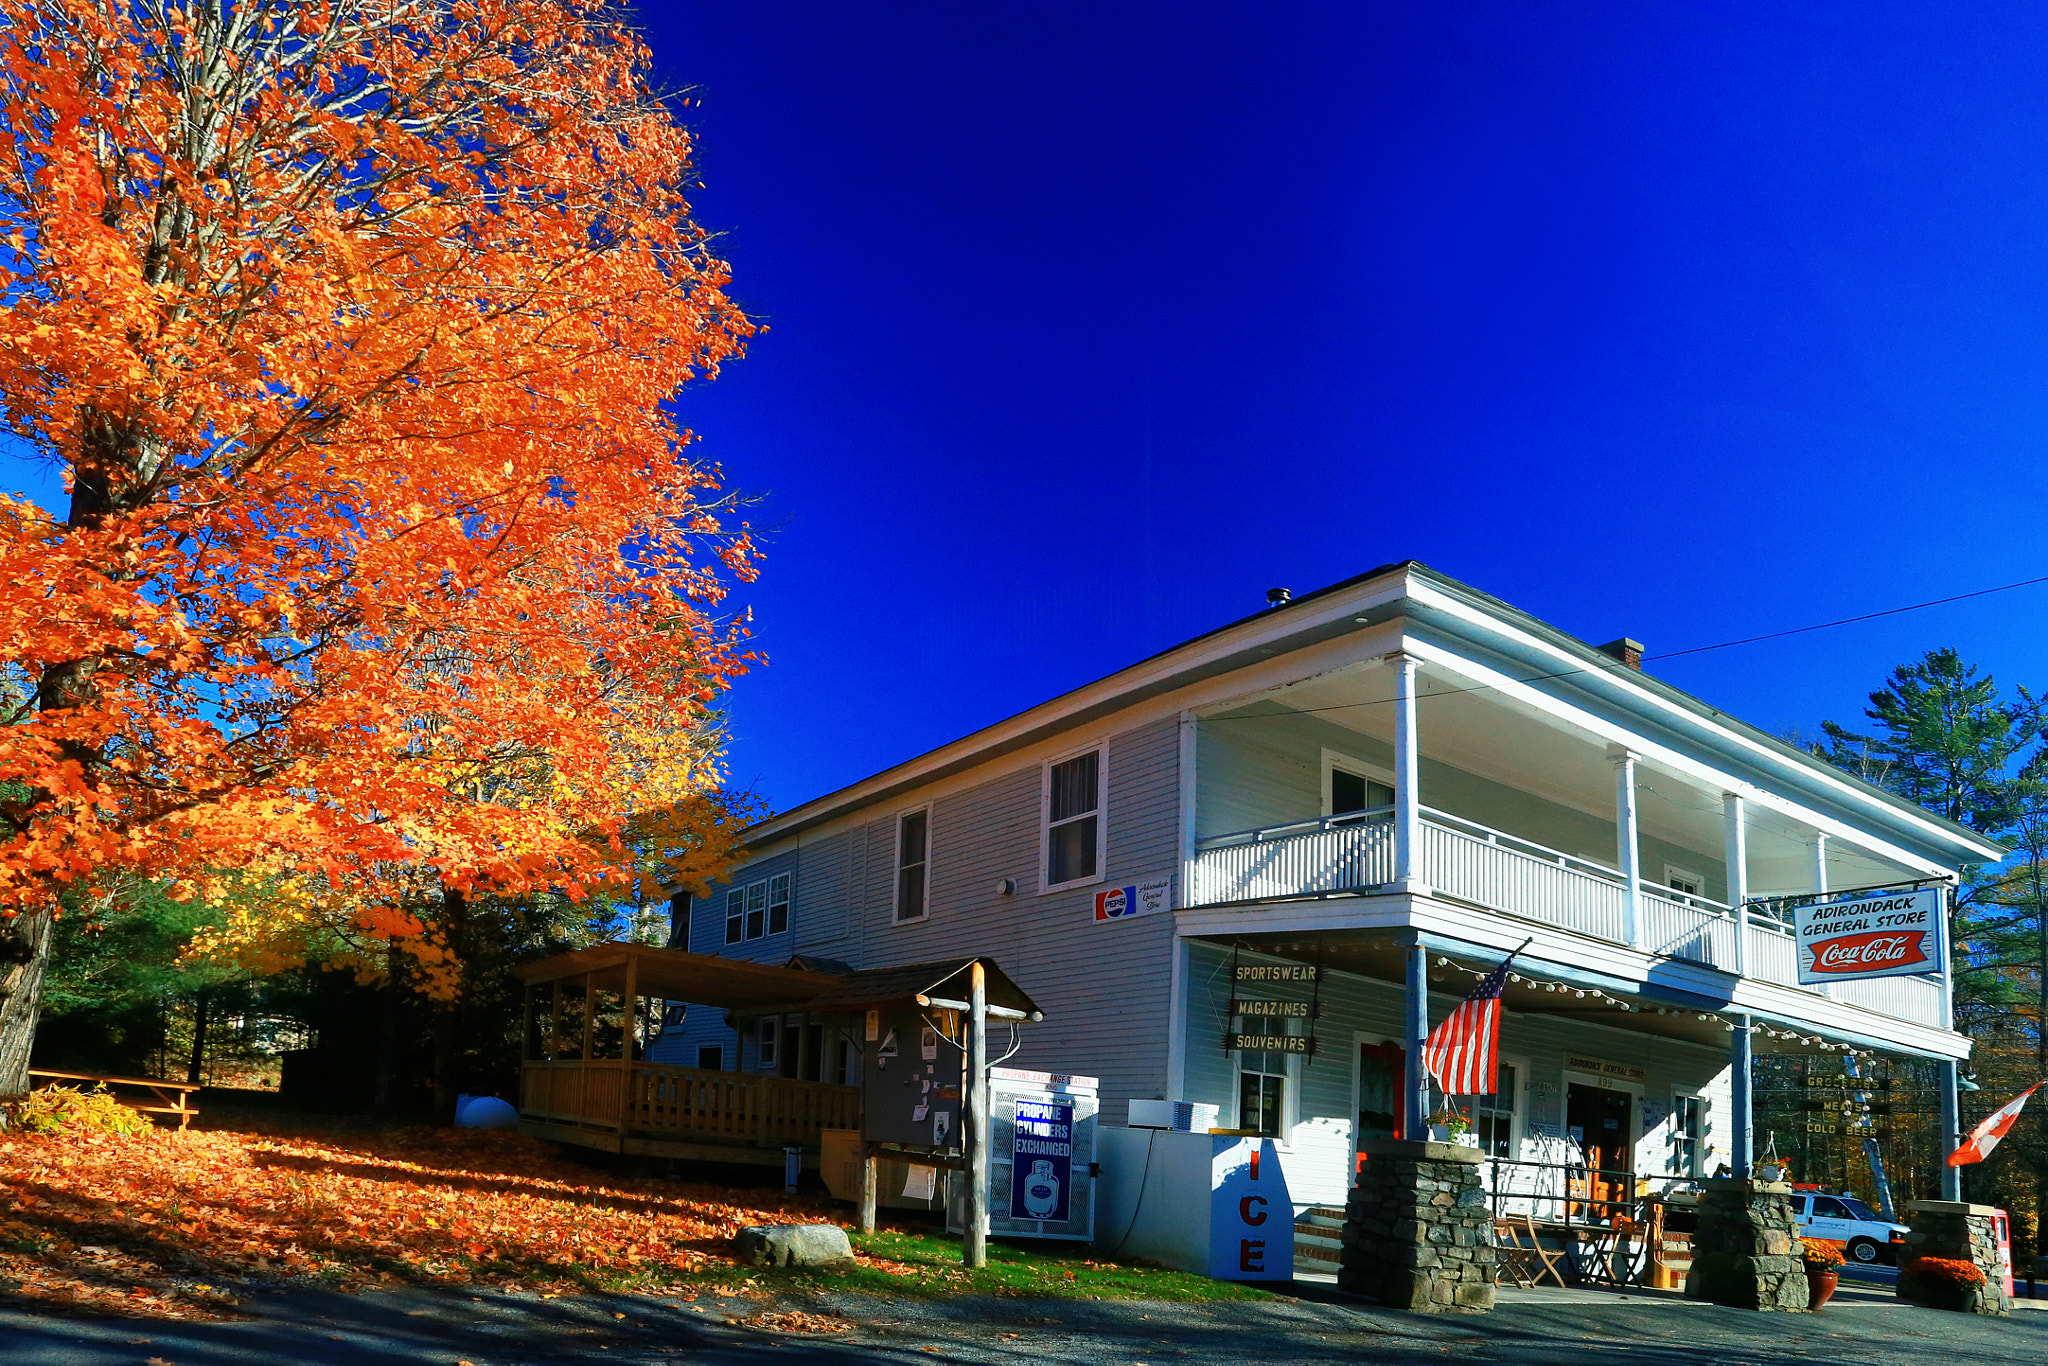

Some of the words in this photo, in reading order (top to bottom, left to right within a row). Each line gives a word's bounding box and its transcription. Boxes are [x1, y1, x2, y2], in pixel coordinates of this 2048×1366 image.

[1105, 897, 1126, 909] PEPSI
[1813, 897, 1916, 920] ADIRONDACK
[1803, 919, 1870, 936] GENERAL
[1876, 910, 1928, 928] STORE
[1821, 936, 1910, 967] Coca-Cola
[1236, 966, 1316, 980] SPORTSWEAR
[1238, 1001, 1308, 1016] MAGAZINES
[1236, 1035, 1305, 1051] SOUVENIRS
[1002, 1069, 1030, 1080] PROPANE
[1033, 1072, 1065, 1084] EXCHANGE
[1065, 1076, 1091, 1086] STATION
[1808, 1077, 1880, 1089] GROCERIES
[1016, 1102, 1061, 1120] PROPANE
[1824, 1101, 1862, 1112] MEATS
[1016, 1120, 1068, 1139] CYLINDERS
[1807, 1123, 1836, 1134] COLD
[1846, 1126, 1877, 1137] BEER
[1016, 1139, 1070, 1157] EXCHANGED
[1240, 1150, 1268, 1272] ICE
